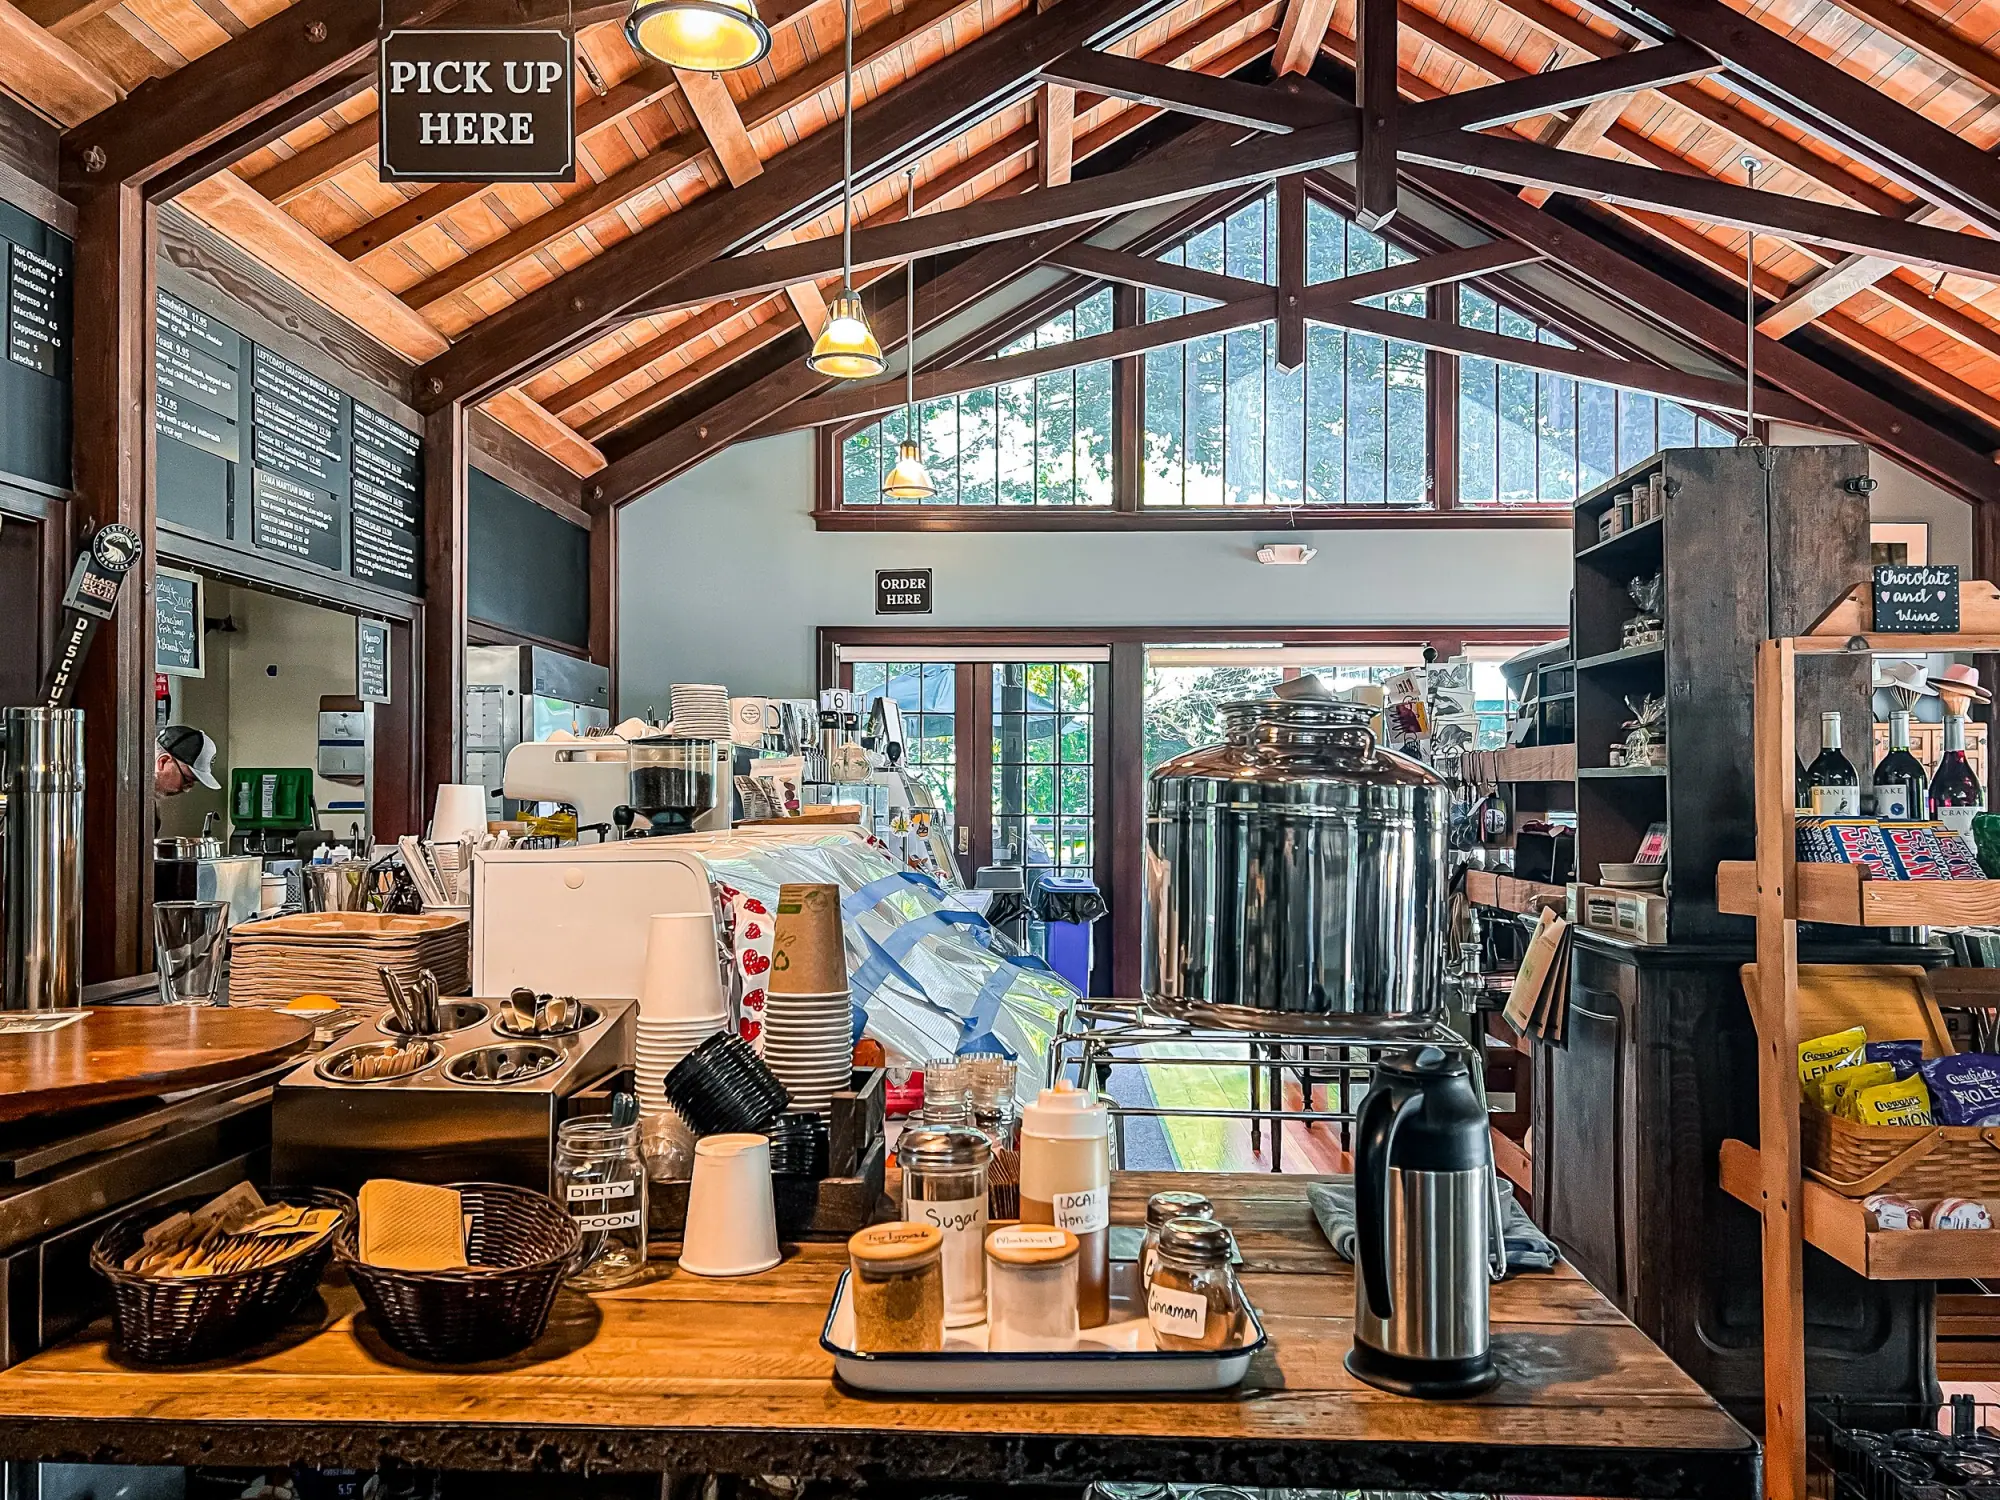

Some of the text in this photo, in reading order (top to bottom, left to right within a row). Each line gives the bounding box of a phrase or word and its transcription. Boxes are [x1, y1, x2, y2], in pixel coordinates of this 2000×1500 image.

[390, 61, 563, 93] PICK UP
[419, 112, 534, 145] HERE
[14, 244, 63, 277] Hot Chocolate 5
[14, 258, 56, 284] Drip Coffee 4
[14, 274, 55, 299] Americano 4
[14, 289, 49, 311] Espresso 4
[13, 305, 45, 325] Macchiato
[159, 293, 187, 317] Sandwich
[191, 311, 207, 328] 11.95
[13, 320, 49, 342] Cappuccino
[13, 336, 39, 353] Latte 5
[176, 343, 189, 358] 9.95
[13, 351, 42, 371] Mocha 5
[257, 348, 284, 371] LEFTCOAST
[285, 364, 308, 384] GRASSFED
[309, 378, 326, 394] BURGER
[164, 397, 177, 410] 7.95
[257, 395, 271, 408] Citrus
[272, 402, 295, 420] Edamame
[296, 414, 318, 432] Sandwich
[258, 429, 273, 445] Classic
[274, 437, 283, 449] BLT
[284, 442, 306, 460] Sandwich
[260, 472, 314, 501] LOMA MARTIAN BOWLS
[372, 487, 392, 503] SANDWICH
[100, 525, 142, 552] DESCHUTES
[98, 553, 129, 570] BREWERY
[83, 578, 117, 594] BUTTE
[85, 572, 118, 588] BLACK
[881, 578, 926, 590] ORDER
[1880, 568, 1951, 586] Chocolate
[886, 594, 921, 605] HERE
[1893, 588, 1932, 603] and
[1895, 608, 1940, 622] Wine
[834, 692, 844, 709] 6
[1950, 1086, 2000, 1104] VIOLE
[571, 1184, 630, 1198] DIRTY
[1060, 1194, 1096, 1210] LOCAL
[579, 1214, 635, 1228] POON
[926, 1208, 979, 1231] Sugar
